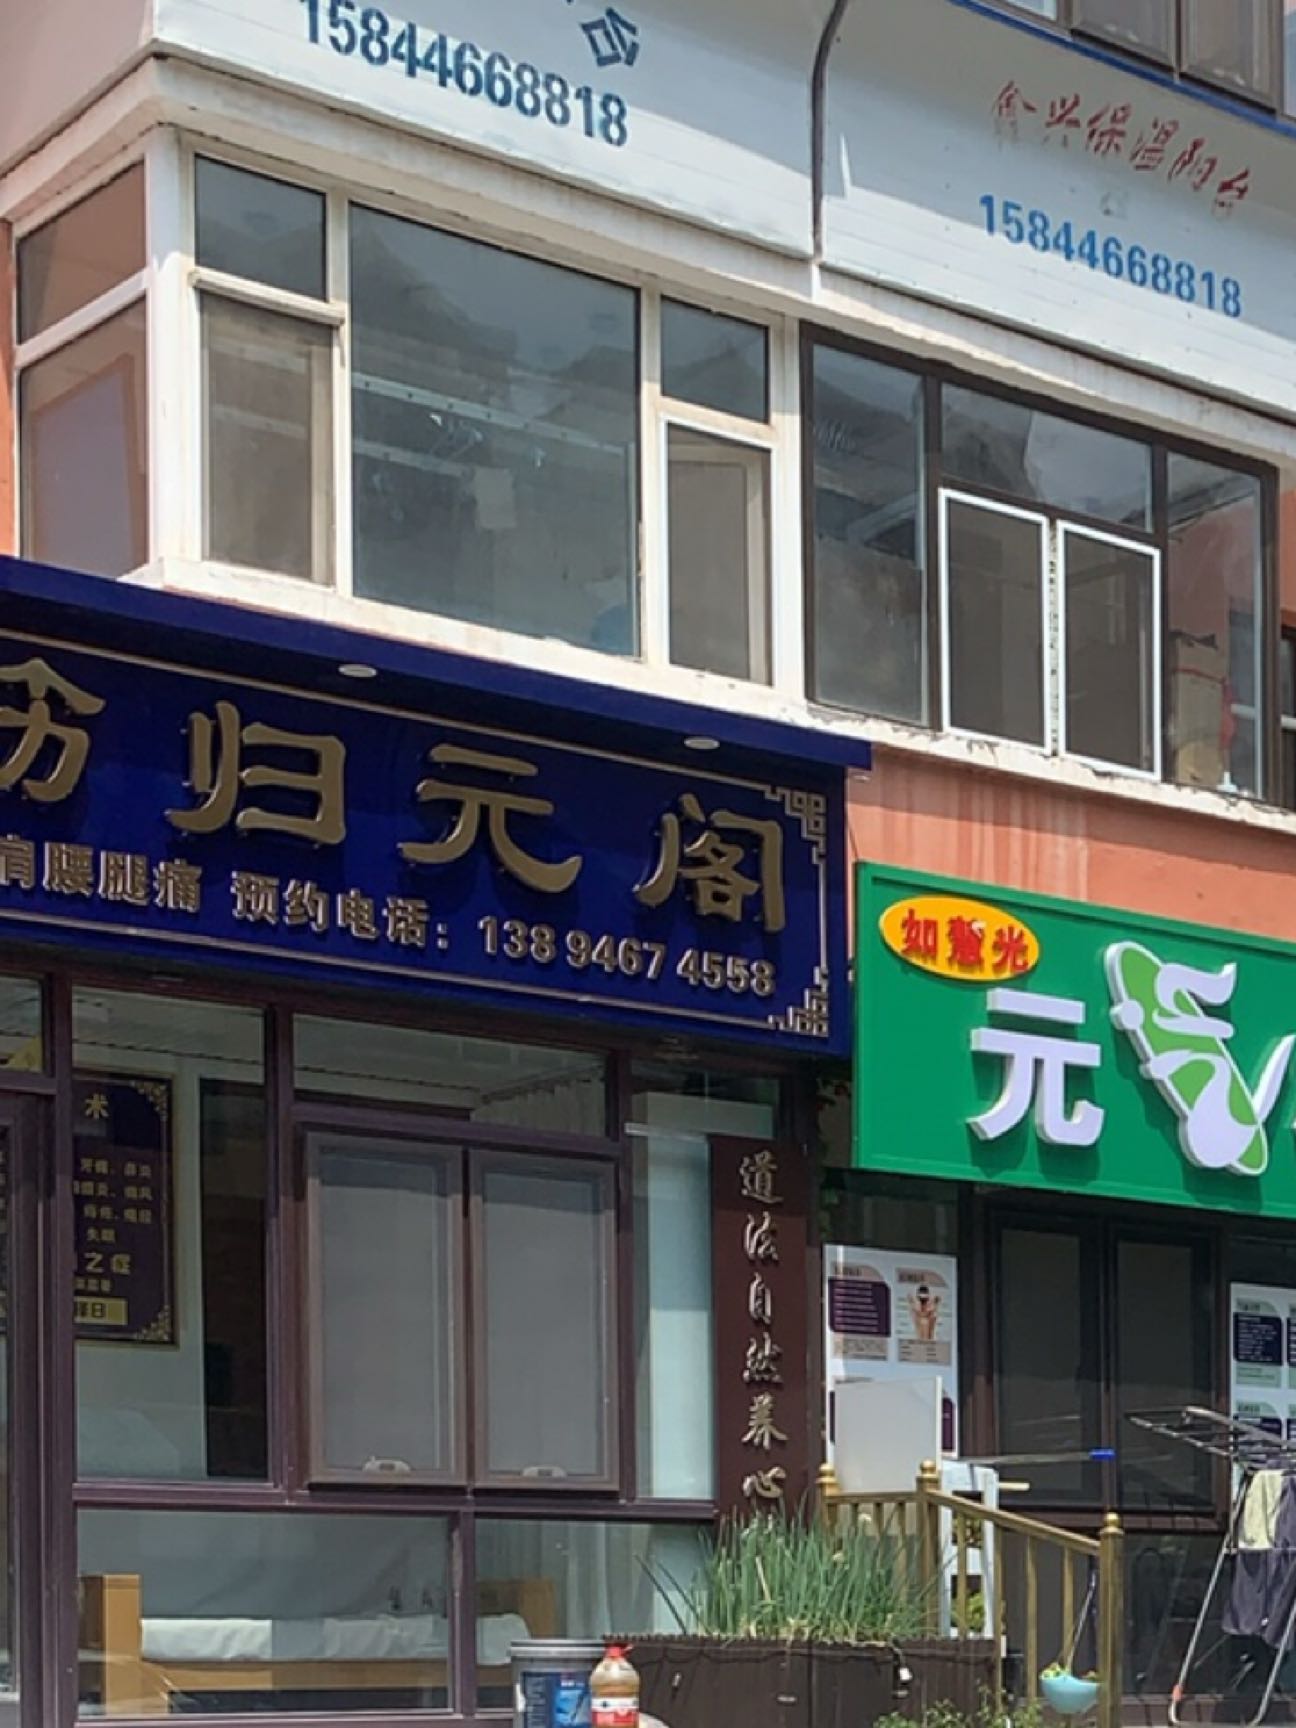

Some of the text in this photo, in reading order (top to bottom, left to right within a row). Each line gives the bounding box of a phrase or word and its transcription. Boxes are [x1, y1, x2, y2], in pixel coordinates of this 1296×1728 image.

[301, 0, 629, 147] 15844668818
[979, 194, 1243, 319] 15844668818
[477, 914, 557, 965] 138
[565, 930, 667, 981] 9467
[676, 949, 777, 997] 4558
